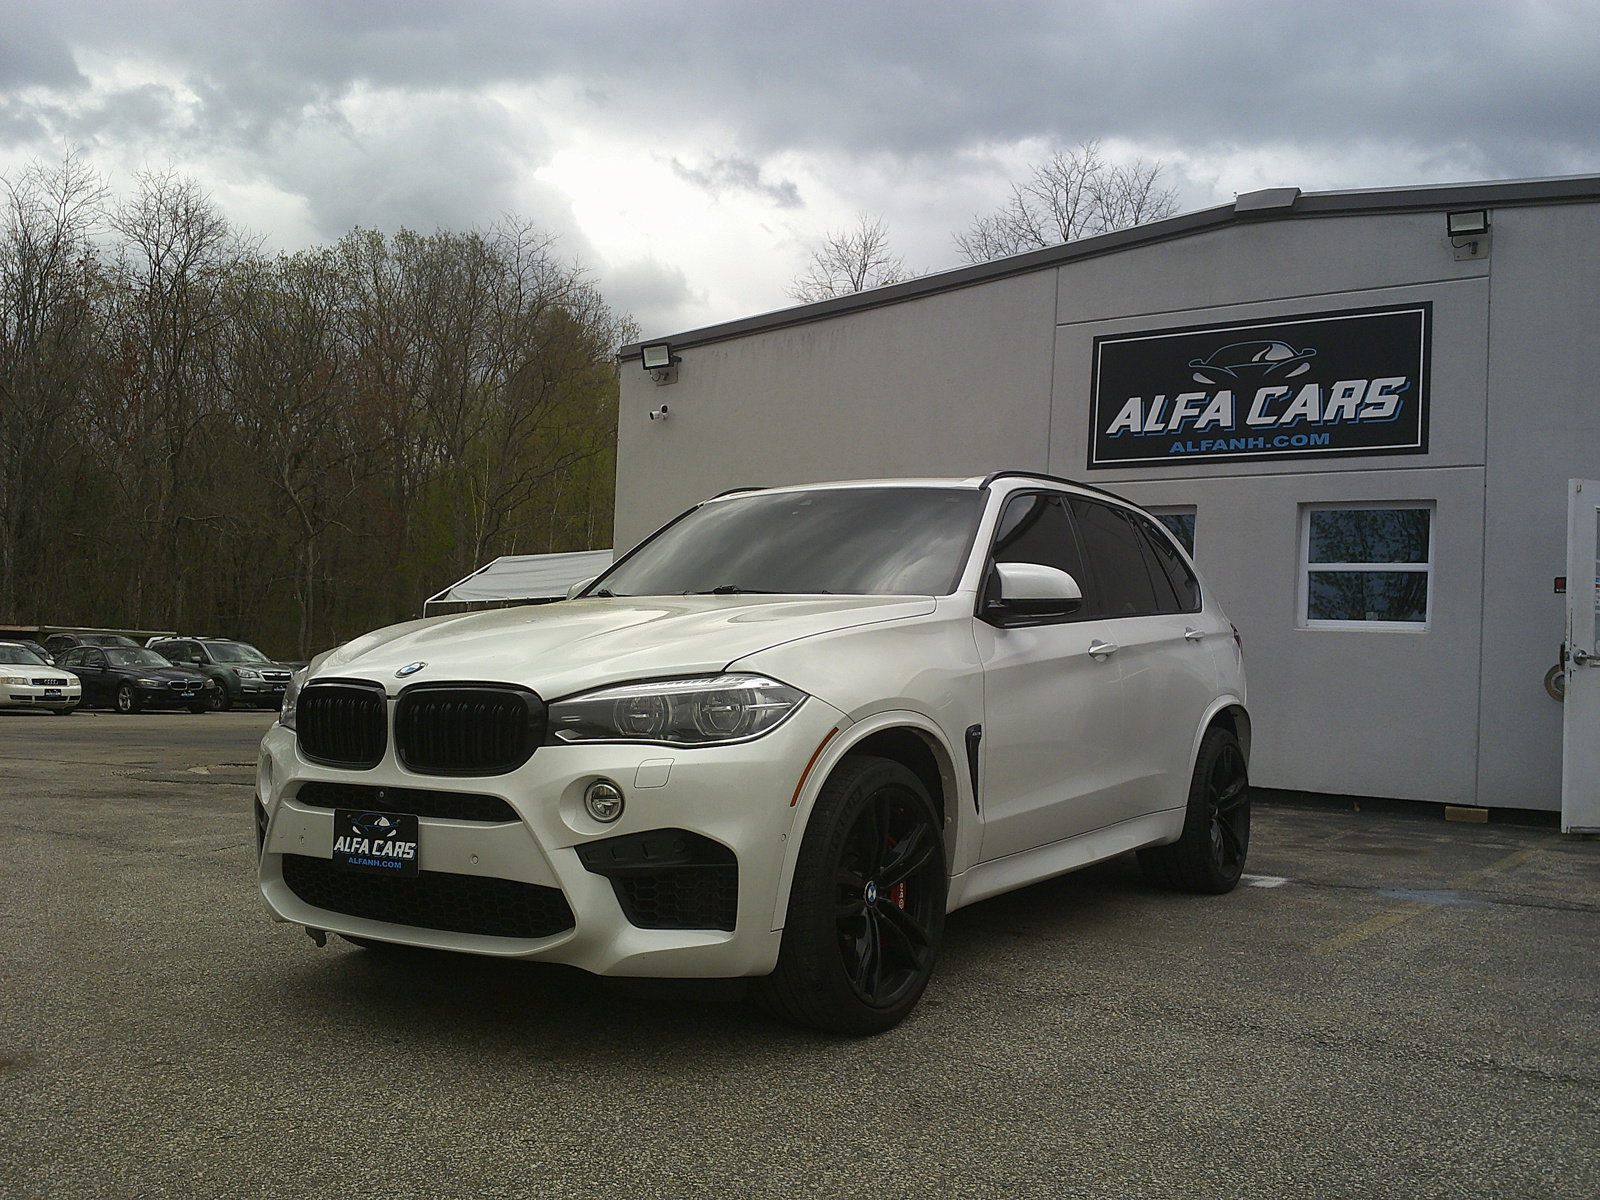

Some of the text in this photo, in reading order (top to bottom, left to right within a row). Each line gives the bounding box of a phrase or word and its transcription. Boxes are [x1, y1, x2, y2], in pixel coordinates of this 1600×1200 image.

[1105, 376, 1411, 439] ALFA CARS
[1169, 432, 1331, 453] ALFANH.COM
[333, 835, 417, 860] ALFA CARS
[348, 857, 402, 869] ALFANH.COM
